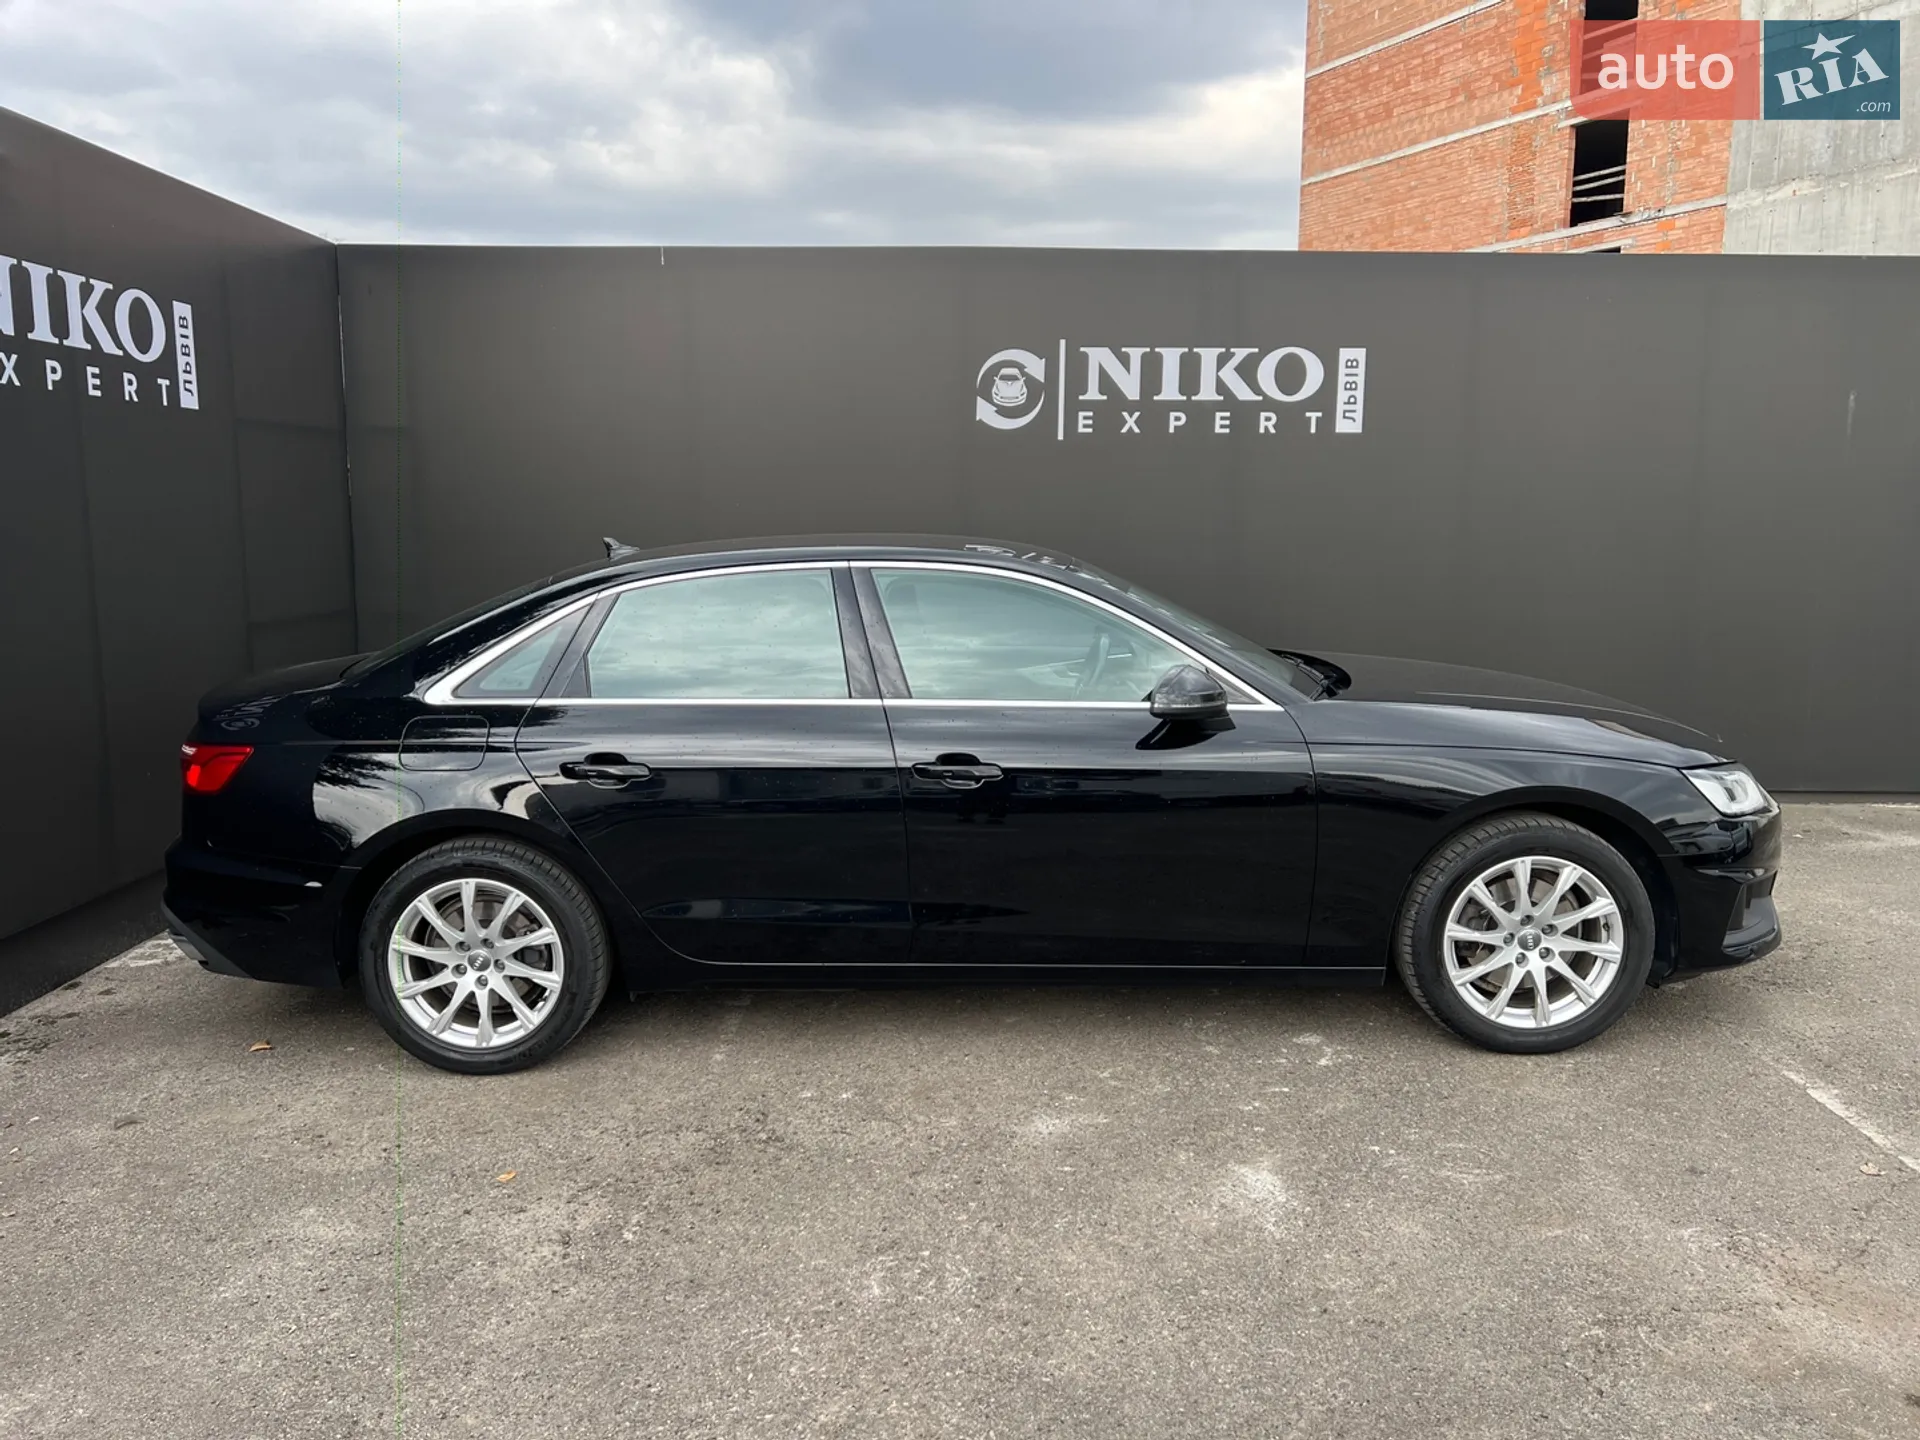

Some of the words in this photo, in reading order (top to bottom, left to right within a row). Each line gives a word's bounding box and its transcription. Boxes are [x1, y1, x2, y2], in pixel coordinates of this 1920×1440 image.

[0, 255, 166, 362] IKO
[179, 315, 195, 397] ЛЬВІВ
[1079, 346, 1324, 402] NIKO
[1077, 411, 1323, 434] EXPERT
[1342, 358, 1360, 423] ЛЬВІВ
